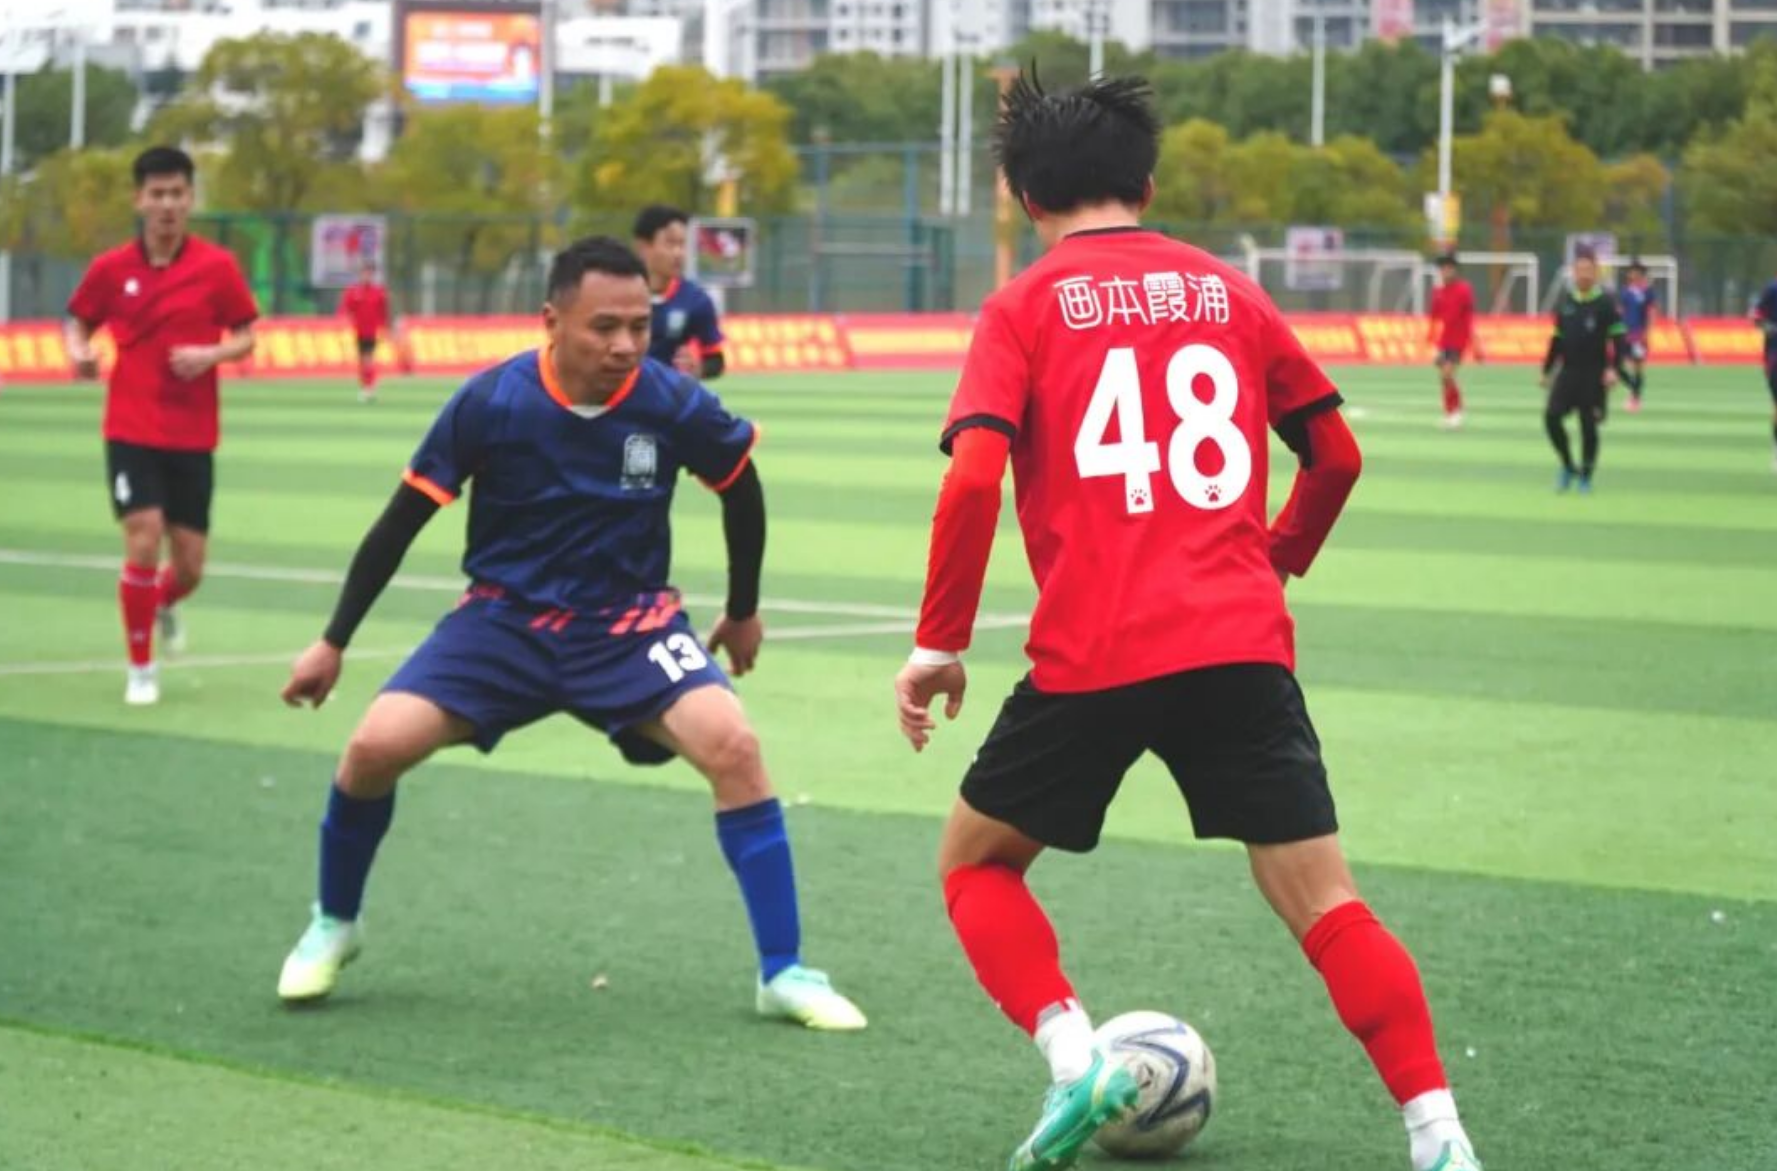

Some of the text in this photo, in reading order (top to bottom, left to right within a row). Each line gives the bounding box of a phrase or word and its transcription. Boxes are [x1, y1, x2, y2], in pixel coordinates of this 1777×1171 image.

[1053, 272, 1230, 329] 画本霞浦
[1074, 344, 1252, 514] 48
[648, 633, 707, 683] 13
